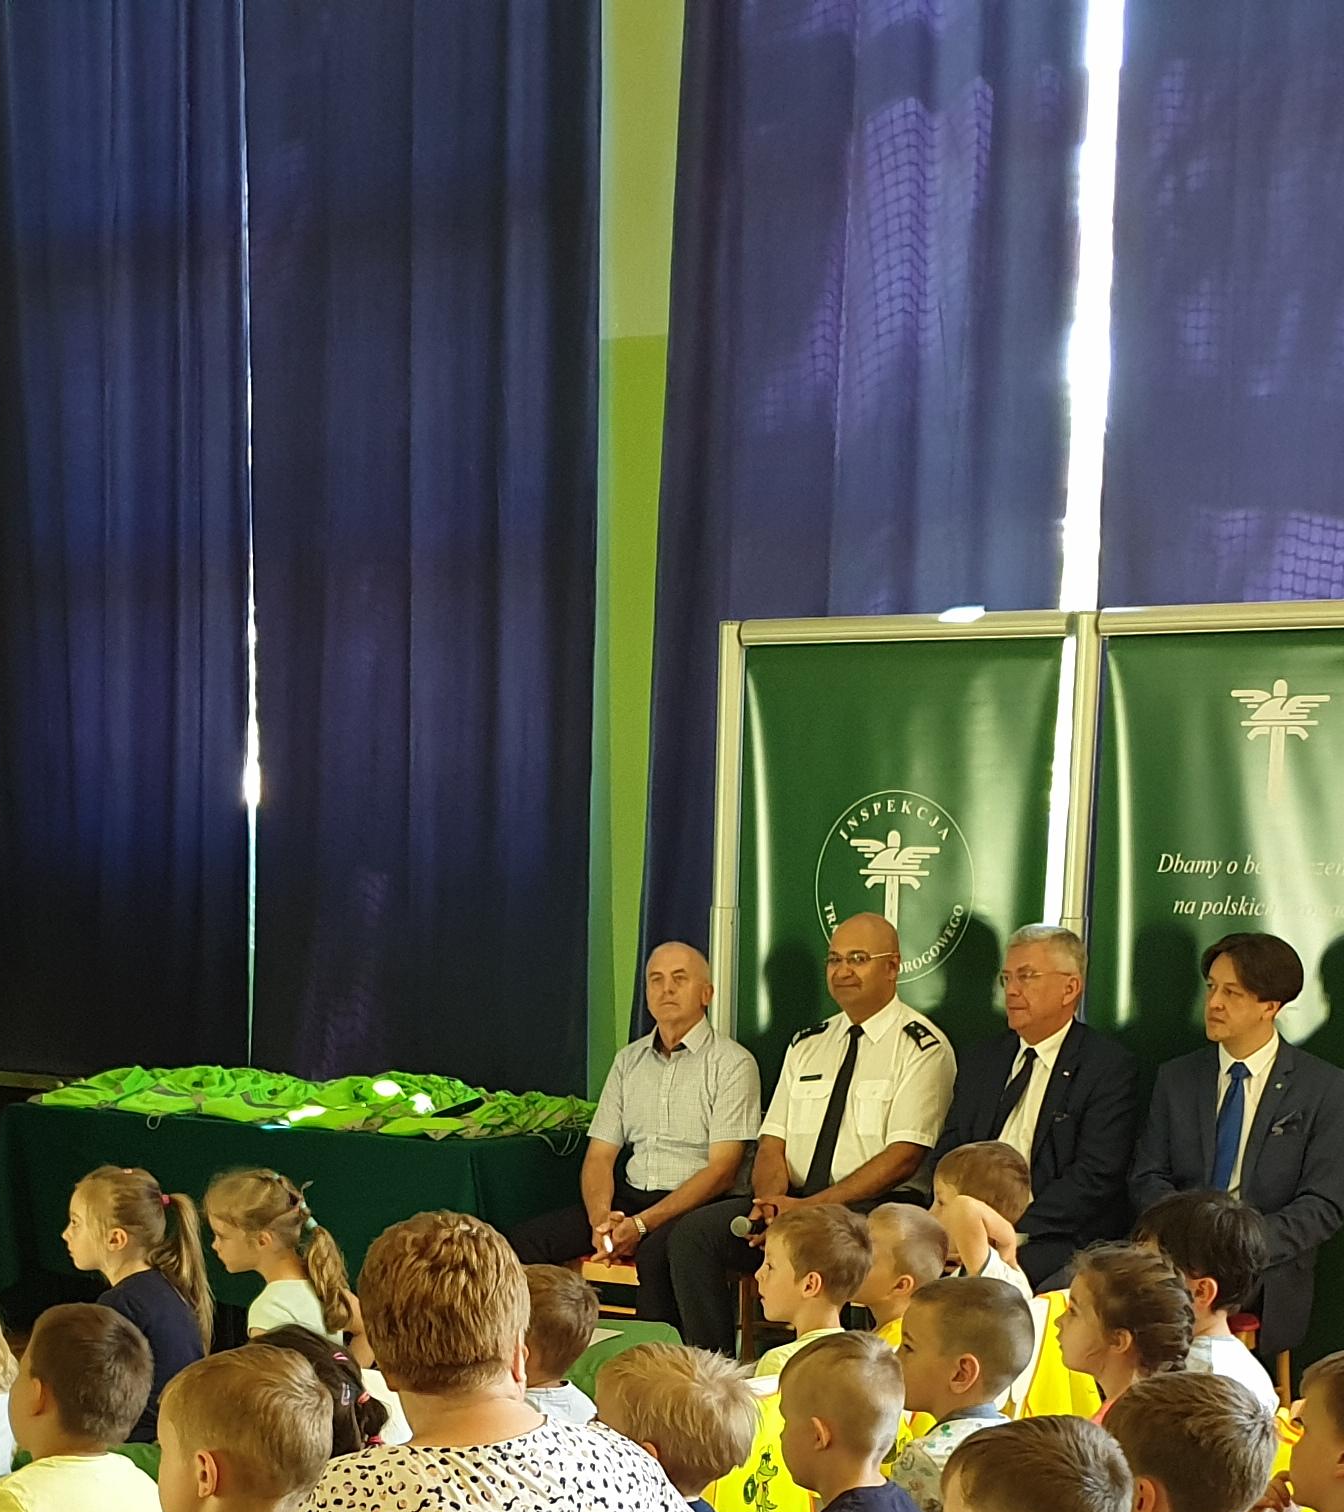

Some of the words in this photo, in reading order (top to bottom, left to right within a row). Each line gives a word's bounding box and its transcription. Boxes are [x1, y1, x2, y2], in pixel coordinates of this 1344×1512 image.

[838, 799, 949, 841] INSPEKCJA
[1156, 853, 1222, 879] Dbamy
[1226, 860, 1238, 874] o
[1173, 899, 1196, 915] na
